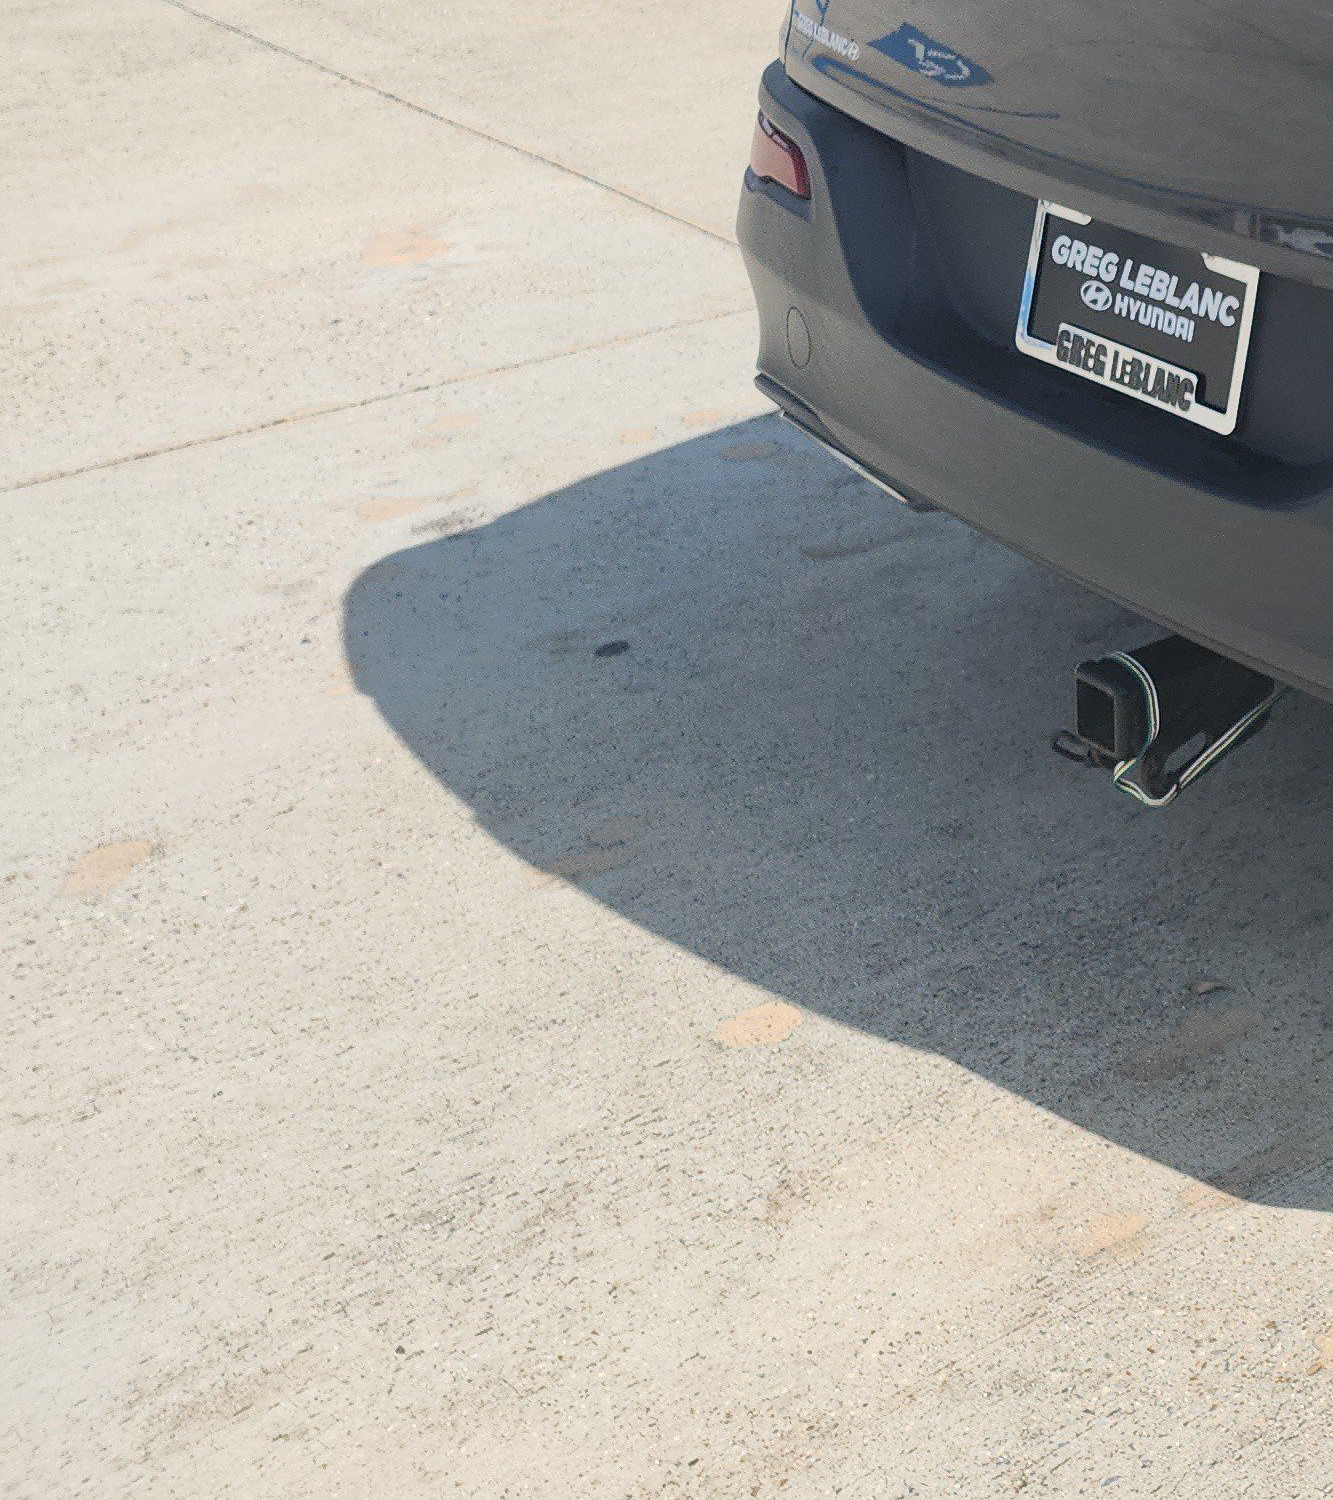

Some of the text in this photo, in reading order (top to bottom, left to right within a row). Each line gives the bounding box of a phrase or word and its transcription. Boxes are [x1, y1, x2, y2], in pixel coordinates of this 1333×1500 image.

[1051, 234, 1240, 327] GREG LEBLANC
[1114, 292, 1195, 343] HYUNDAI
[1056, 329, 1195, 412] GREG LEBLANC
